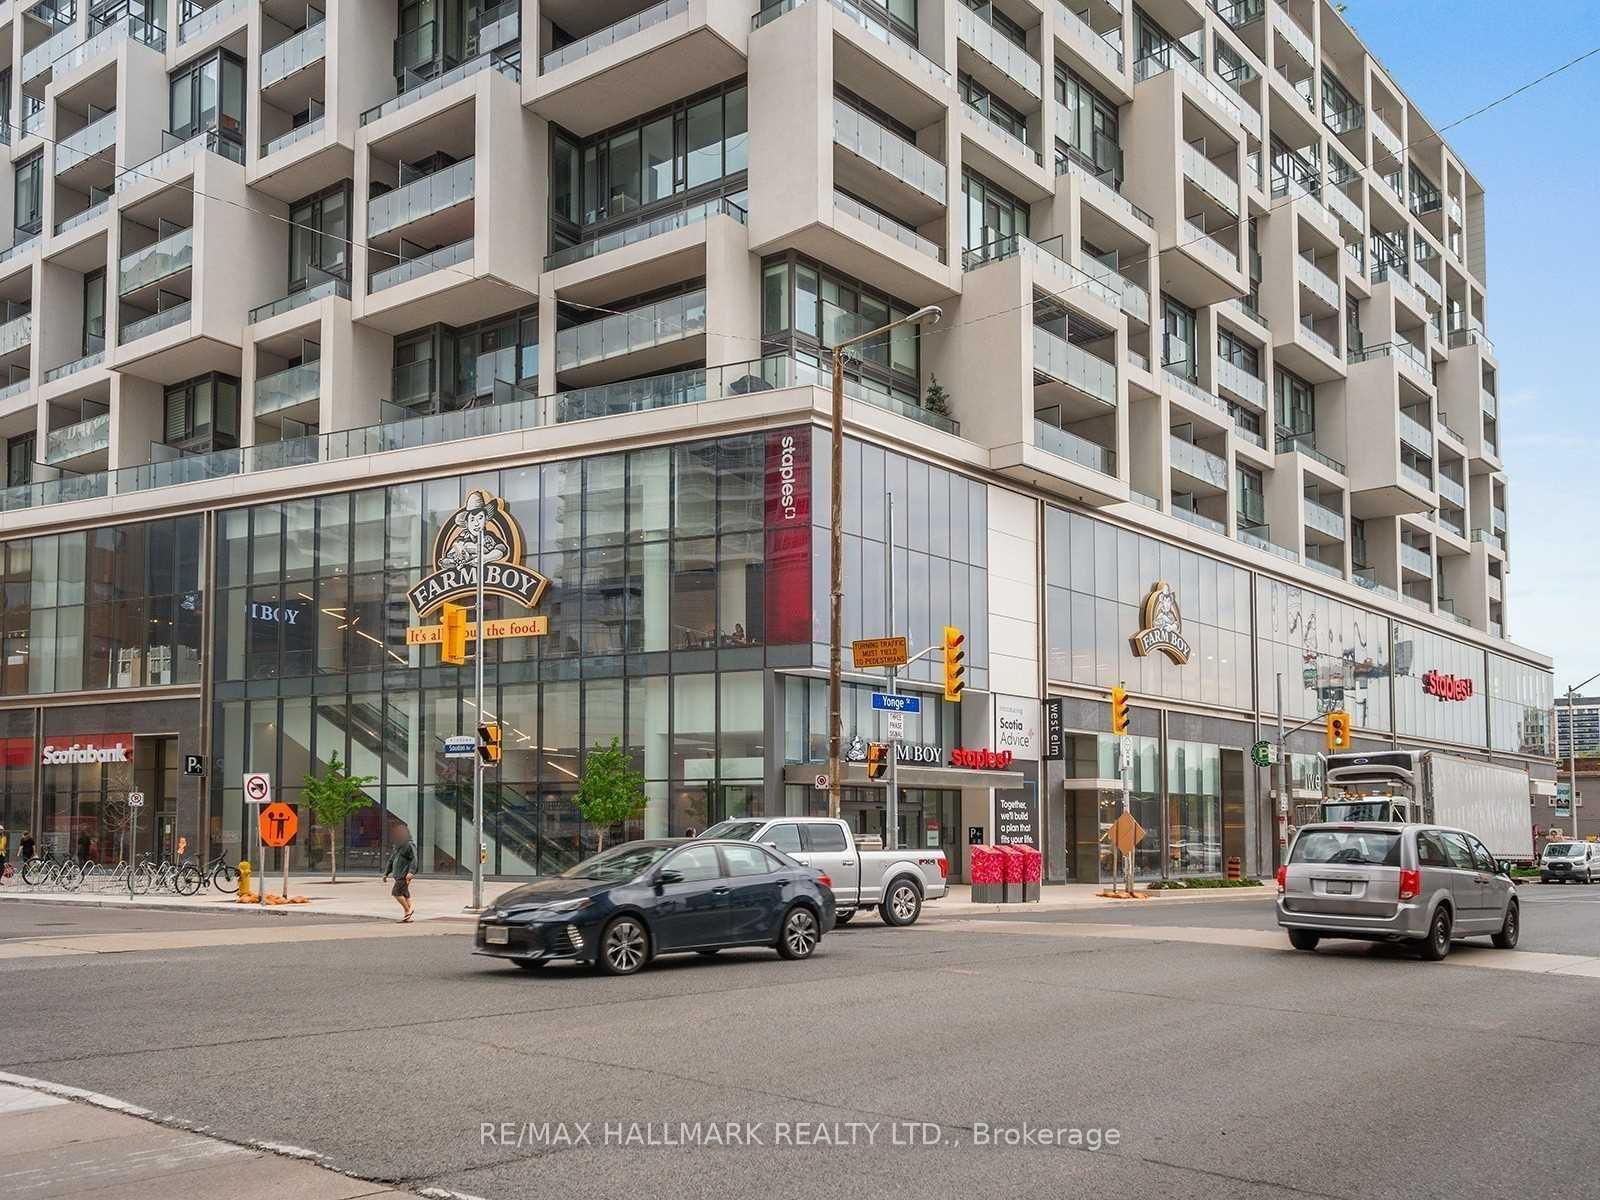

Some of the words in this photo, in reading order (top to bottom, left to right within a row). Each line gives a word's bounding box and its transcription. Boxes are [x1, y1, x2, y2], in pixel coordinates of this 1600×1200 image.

[780, 436, 796, 507] staples
[413, 567, 478, 609] FARM
[484, 565, 537, 596] BOY
[411, 629, 426, 642] It's
[431, 628, 442, 641] al
[487, 624, 505, 636] the
[510, 620, 540, 635] food.
[854, 640, 878, 649] TURNING
[880, 639, 904, 648] TRAFFIC
[1142, 629, 1170, 650] FARM
[1171, 632, 1190, 655] BOY
[856, 658, 864, 666] TO
[865, 656, 905, 665] PEDESTRIANS
[862, 649, 878, 657] MUST
[880, 648, 898, 656] YIELD
[1425, 670, 1470, 701] staples
[882, 695, 905, 710] Yonge
[1000, 717, 1023, 731] Scotia
[1050, 703, 1060, 732] west
[1000, 732, 1030, 747] Advice
[1050, 734, 1061, 756] elm
[42, 743, 127, 765] Scotiabank
[914, 745, 942, 763] BOY
[952, 747, 1006, 769] staples
[187, 756, 197, 773] P
[1306, 774, 1321, 791] we
[1001, 800, 1026, 810] Together,
[1001, 812, 1013, 820] we'll
[1015, 812, 1028, 820] build
[1001, 824, 1006, 832] a
[1006, 823, 1019, 833] plan
[1020, 823, 1031, 832] that
[1001, 835, 1010, 843] fits
[1010, 836, 1023, 844] your
